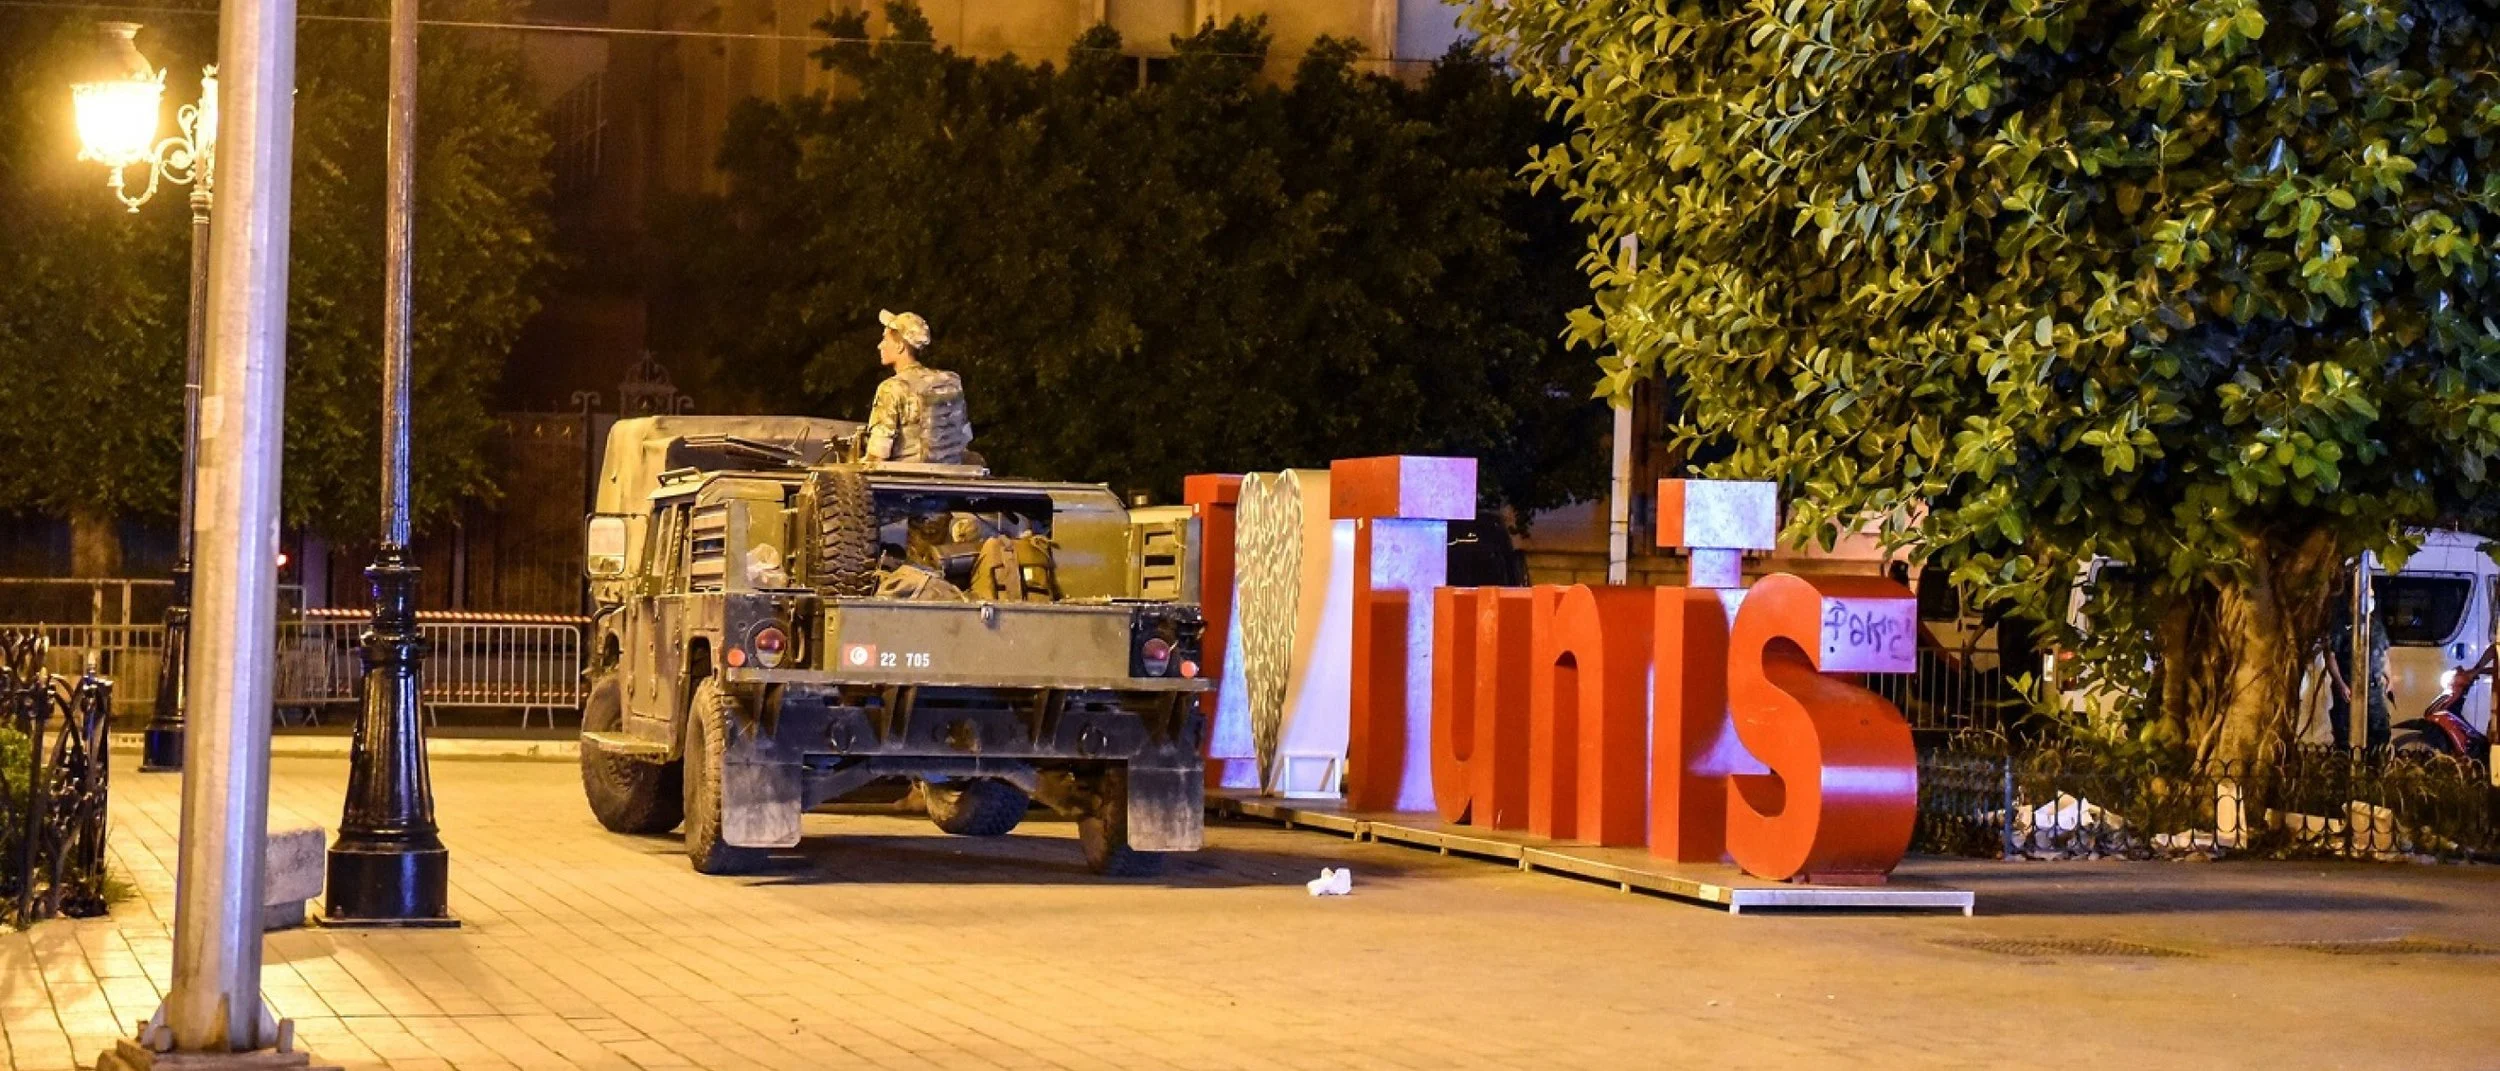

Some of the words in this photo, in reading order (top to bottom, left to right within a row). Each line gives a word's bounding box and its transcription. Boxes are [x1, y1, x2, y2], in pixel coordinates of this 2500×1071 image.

[880, 651, 897, 668] 22
[905, 651, 931, 668] 705
[1330, 456, 1917, 883] Tunis
